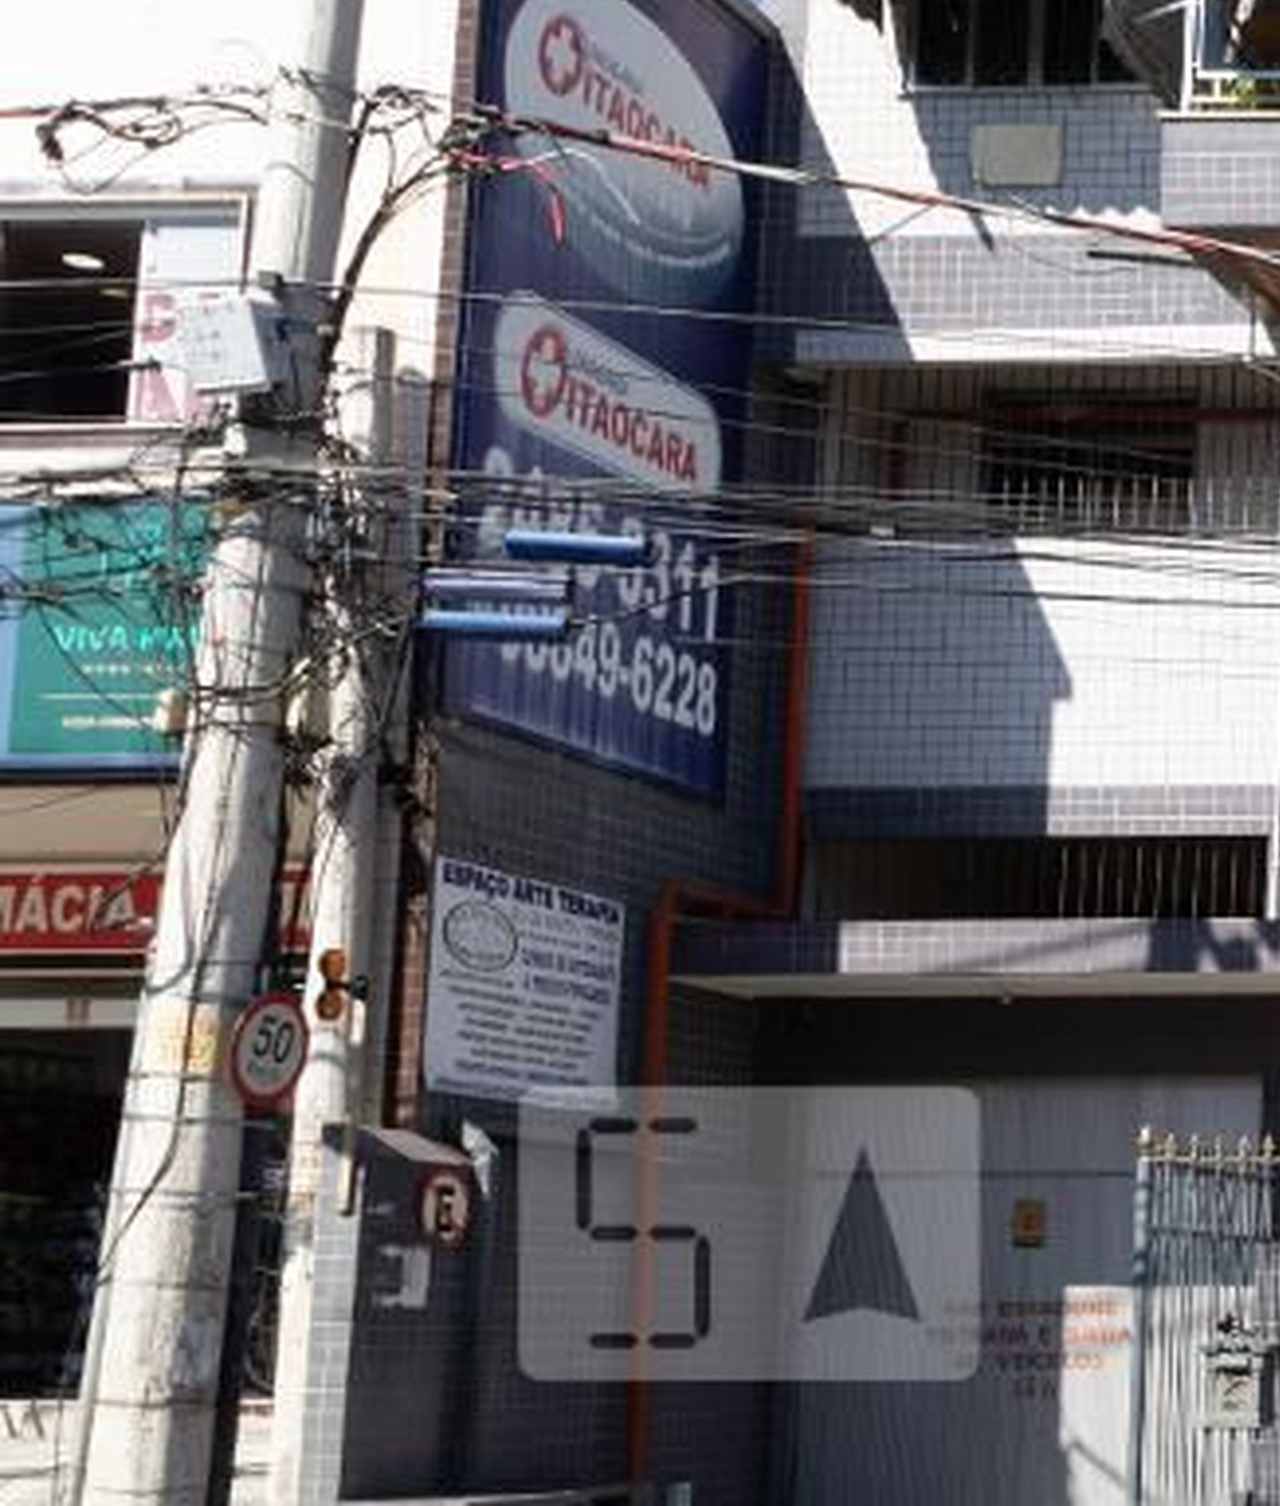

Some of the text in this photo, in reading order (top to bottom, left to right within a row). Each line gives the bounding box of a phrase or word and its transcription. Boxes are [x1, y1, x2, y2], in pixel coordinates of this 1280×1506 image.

[566, 376, 696, 481] ITAOCARA
[53, 625, 127, 651] VIVA
[443, 862, 511, 899] ESPAÇO
[514, 879, 554, 910] ARTE
[558, 891, 620, 925] TERAPIA
[253, 1015, 295, 1064] 50
